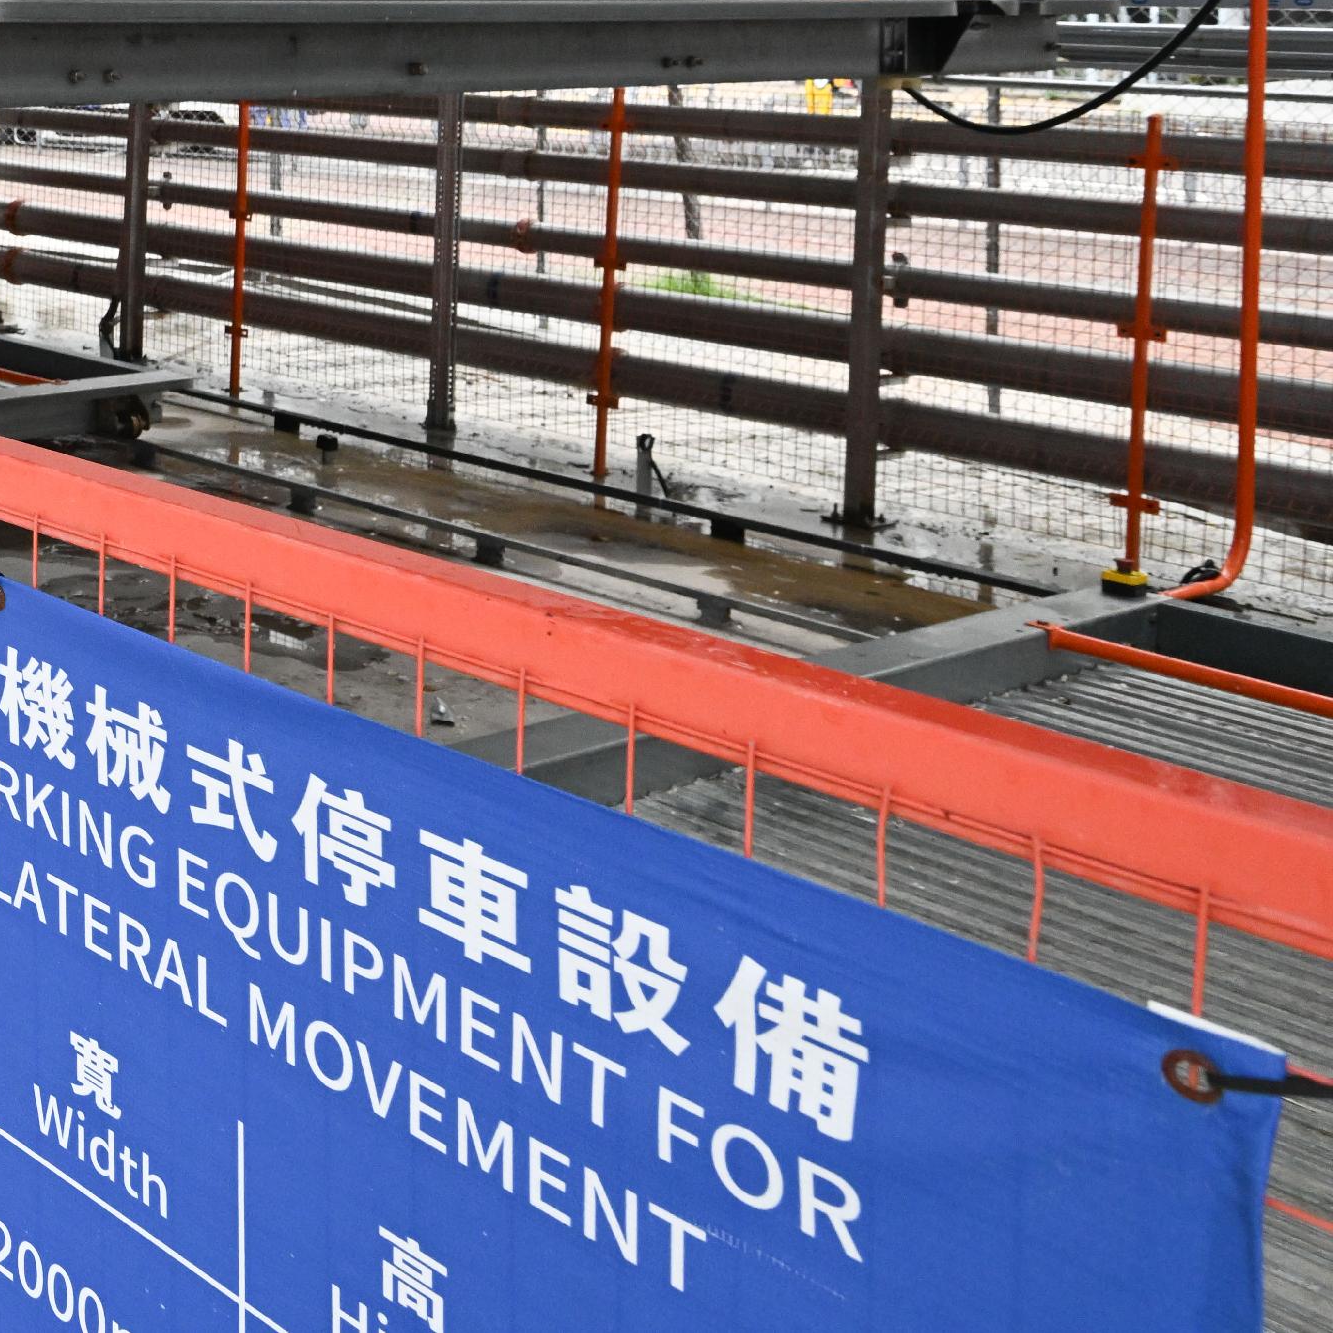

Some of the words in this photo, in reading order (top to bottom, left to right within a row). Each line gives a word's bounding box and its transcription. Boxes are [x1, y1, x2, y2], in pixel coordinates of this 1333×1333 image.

[69, 1030, 122, 1121] 寬
[176, 846, 627, 1129] EQUIPMENT
[657, 1085, 863, 1264] FOR
[34, 1083, 169, 1220] Width
[249, 981, 707, 1292] MOVEMENT
[378, 1225, 449, 1333] 高
